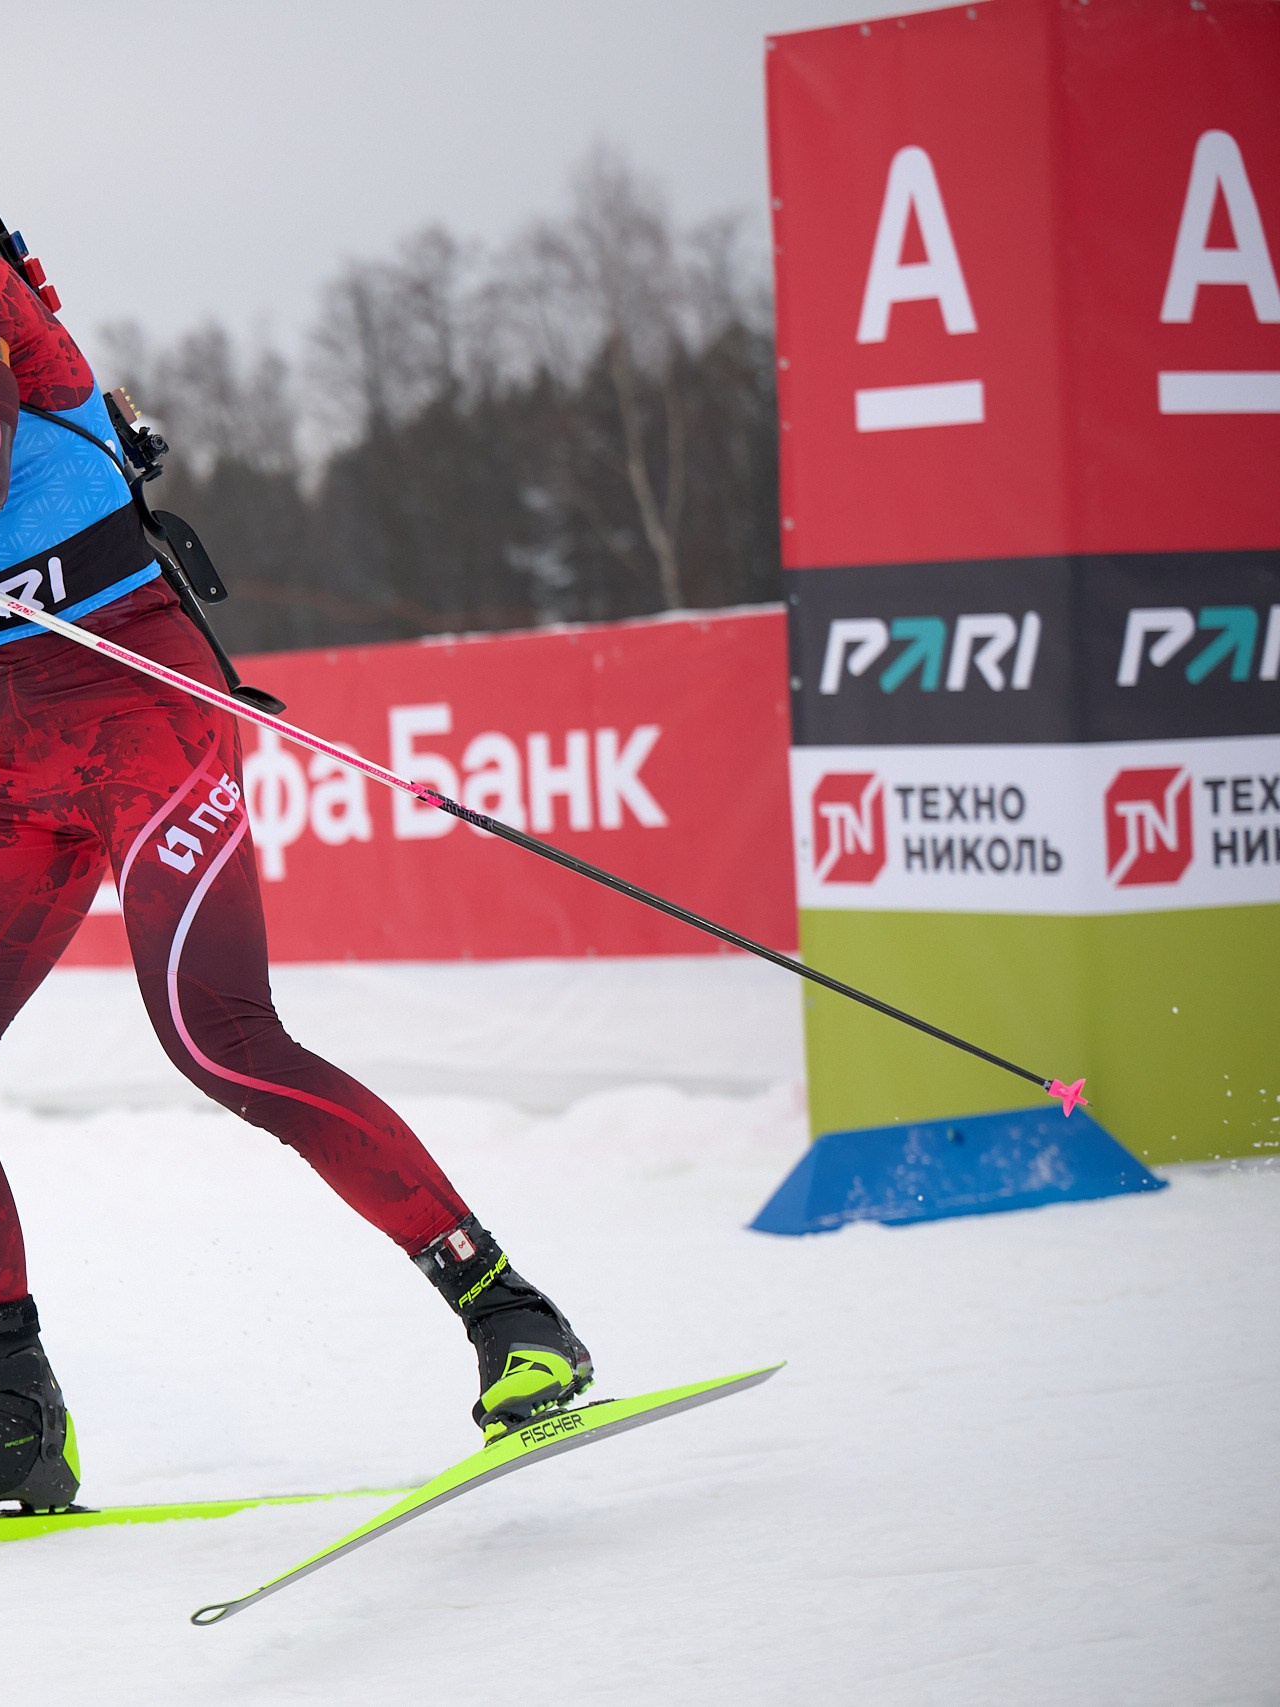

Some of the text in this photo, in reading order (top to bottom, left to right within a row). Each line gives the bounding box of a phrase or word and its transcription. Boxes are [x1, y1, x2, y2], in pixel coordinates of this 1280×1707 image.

[819, 610, 1042, 696] PARI
[188, 773, 241, 835] ПСБ
[241, 702, 669, 881] фа Банк
[894, 785, 1026, 822] ТЕХНО
[1203, 775, 1280, 815] ТЕХ
[904, 836, 1063, 874] НИКОЛЬ
[1213, 827, 1280, 867] НИ
[458, 1252, 508, 1309] FISCHER
[520, 1413, 586, 1448] FISCHER
